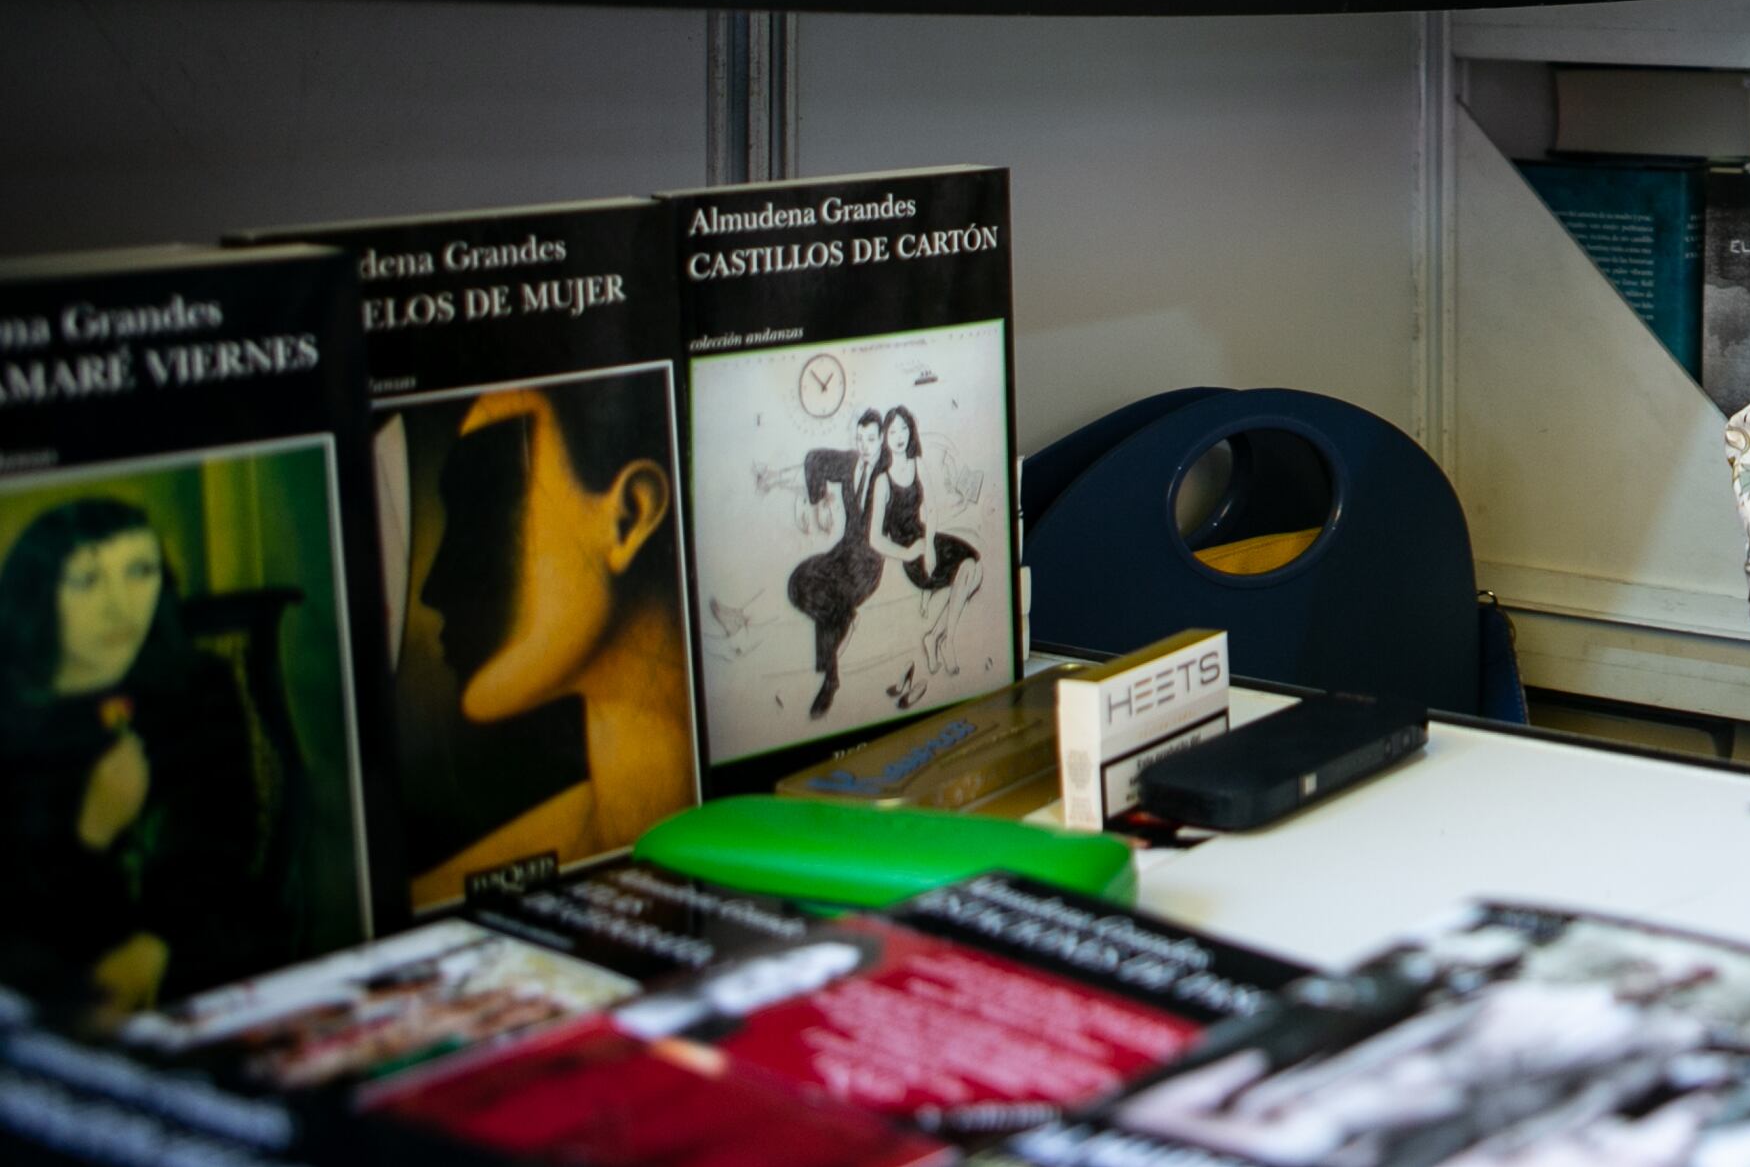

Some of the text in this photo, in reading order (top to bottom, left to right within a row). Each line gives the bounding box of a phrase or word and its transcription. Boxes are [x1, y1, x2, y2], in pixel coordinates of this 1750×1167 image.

[689, 192, 916, 237] Almudena Grandes
[443, 234, 566, 272] Grandes
[689, 223, 999, 281] CASTILLOS DE CARTÓN
[60, 294, 223, 342] Grandes
[465, 284, 509, 320] DE
[522, 274, 627, 318] MUJER
[146, 334, 319, 387] VIERNES
[690, 326, 804, 352] colección andanzas
[1107, 650, 1222, 725] HEETS
